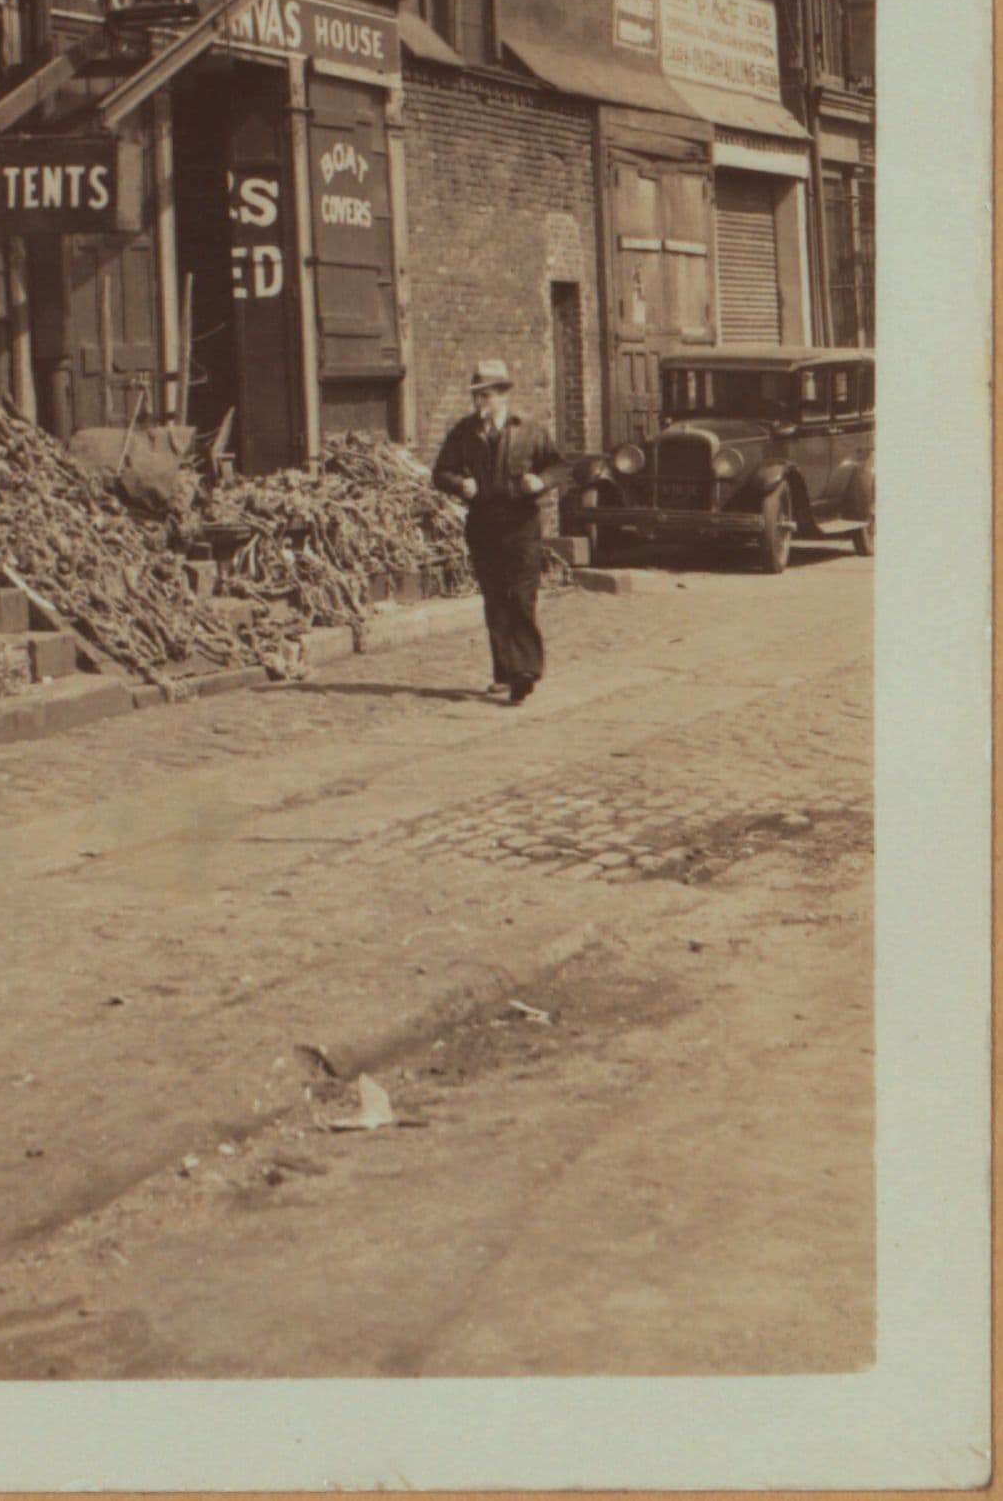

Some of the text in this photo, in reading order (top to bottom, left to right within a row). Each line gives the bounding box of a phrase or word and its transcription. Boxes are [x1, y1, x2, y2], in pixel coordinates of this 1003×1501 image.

[314, 15, 385, 60] HOUSE
[319, 142, 370, 185] BOAT
[3, 165, 109, 210] TENTS
[320, 194, 373, 229] COVERS
